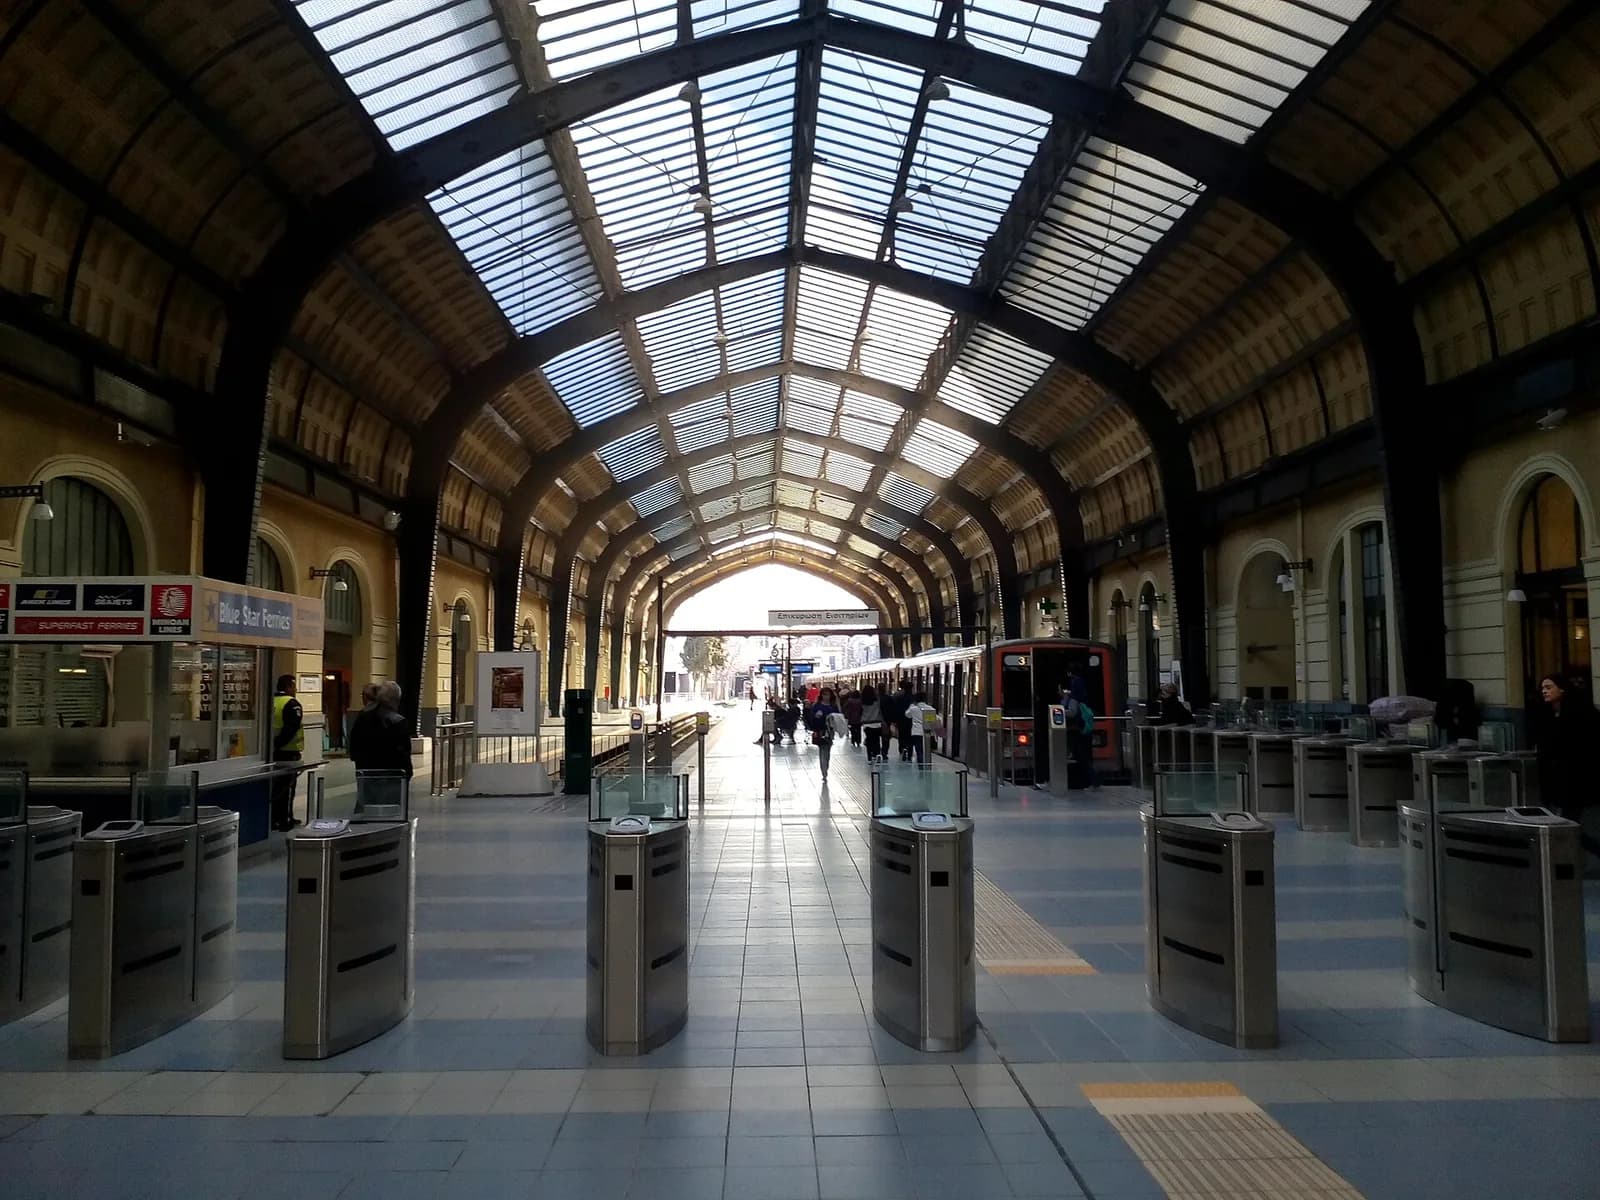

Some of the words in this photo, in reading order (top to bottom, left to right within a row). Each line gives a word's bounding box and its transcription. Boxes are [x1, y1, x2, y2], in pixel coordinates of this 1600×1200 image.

[219, 601, 240, 625] Blue
[242, 605, 261, 627] Star
[262, 608, 291, 630] Ferries
[38, 621, 95, 630] SUPERFAST
[97, 621, 139, 630] FERRIES
